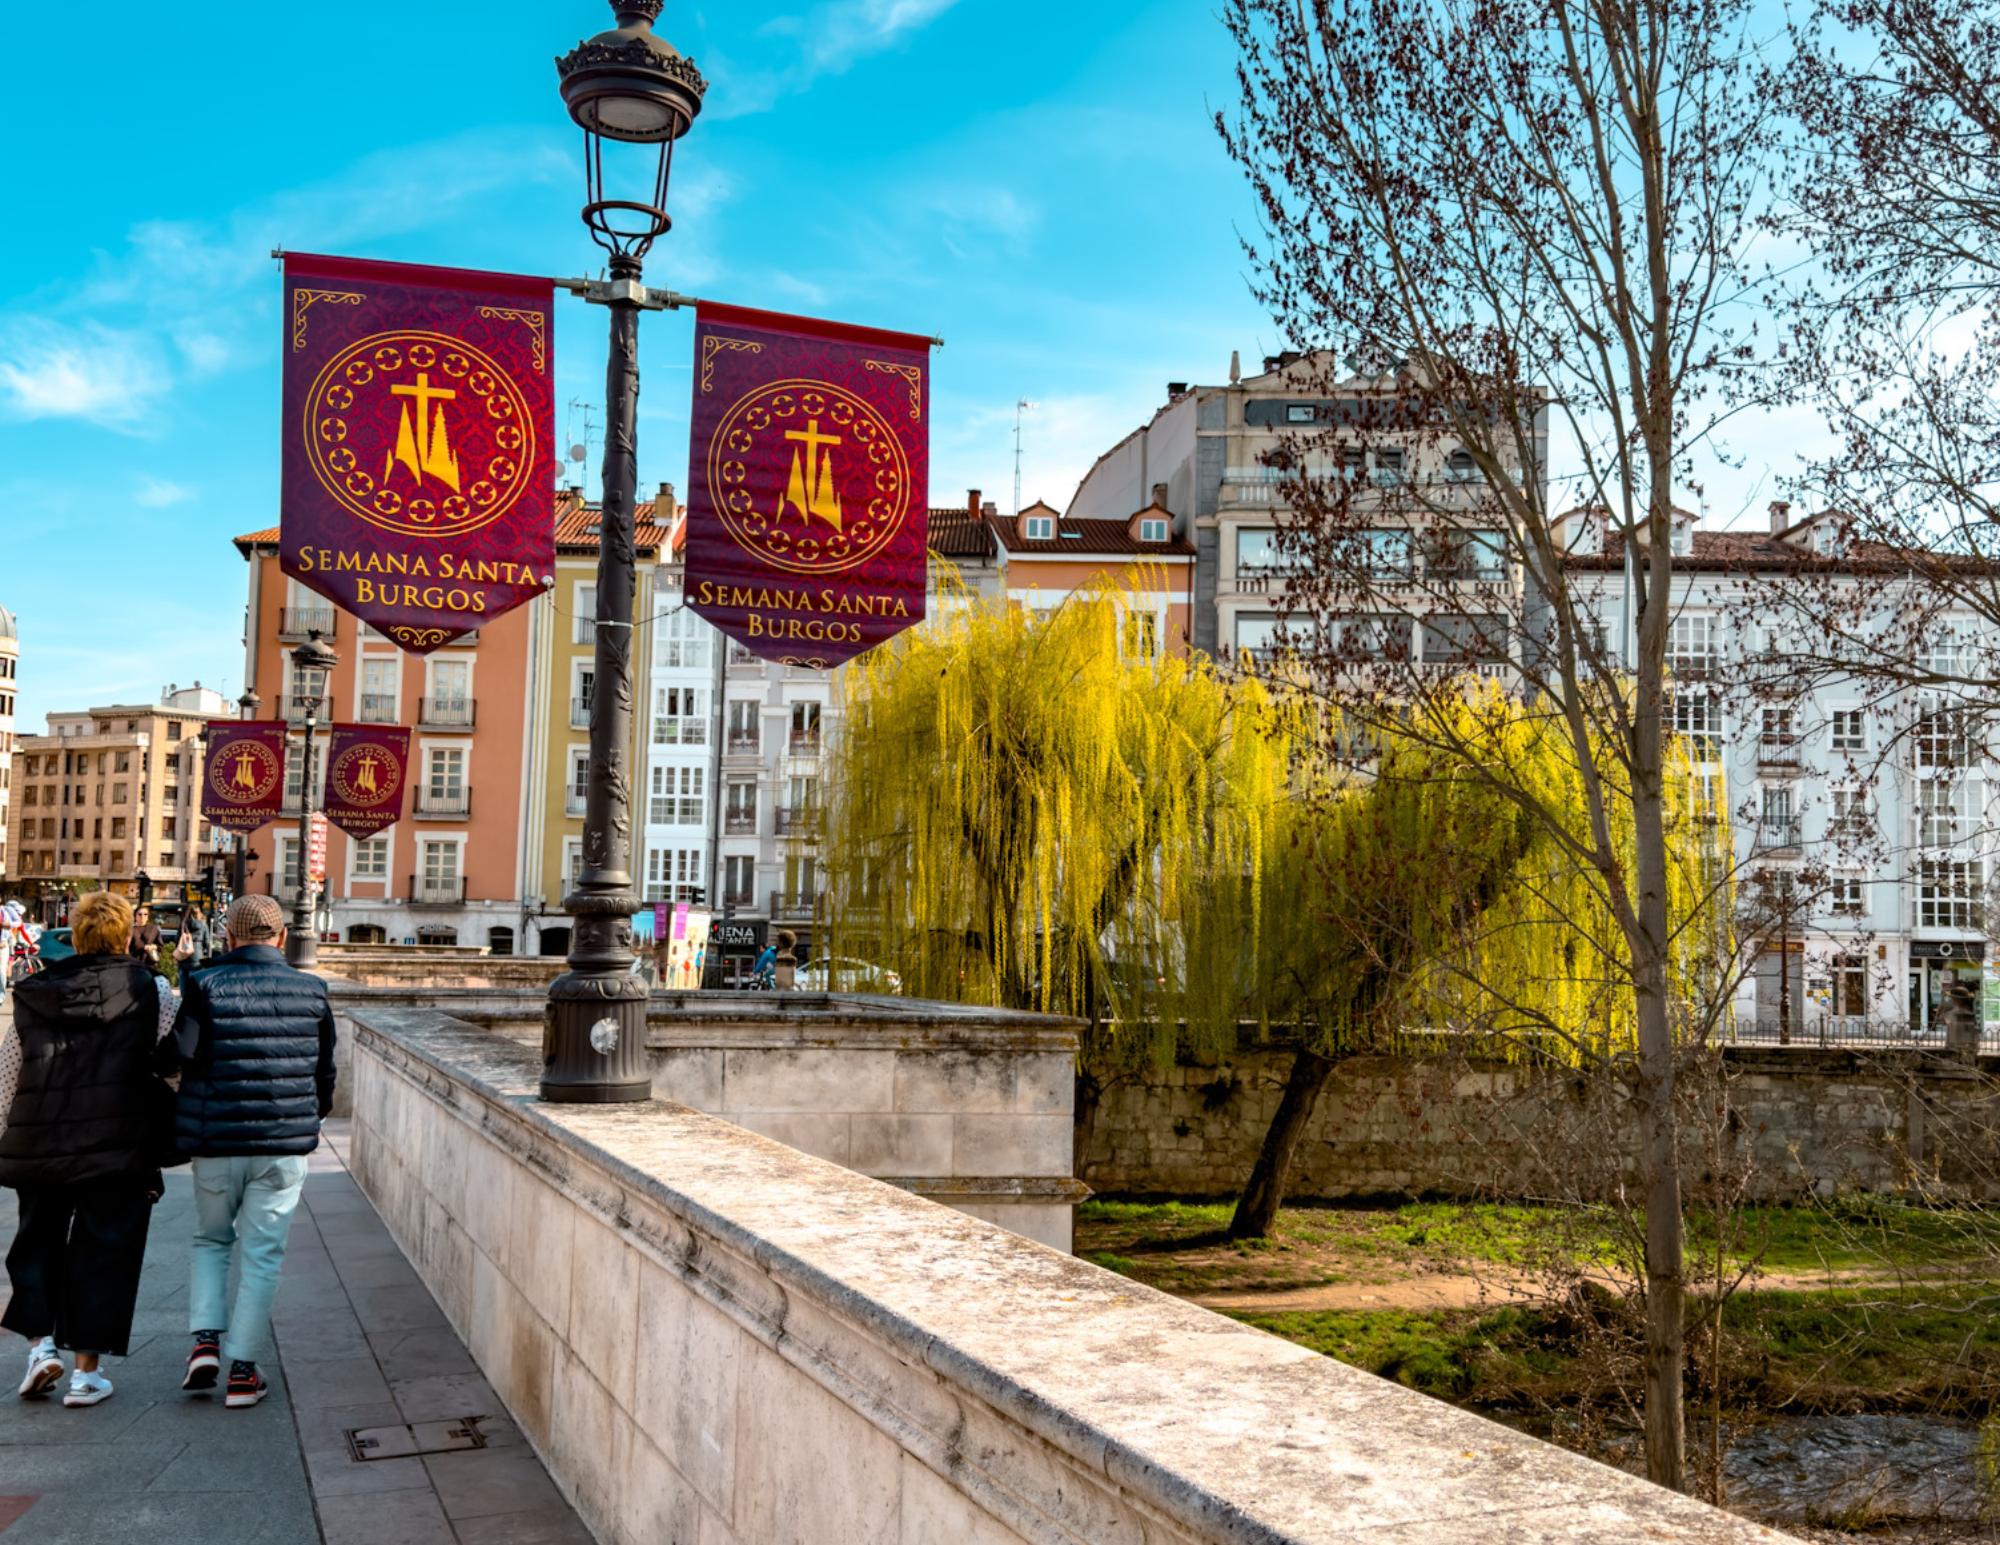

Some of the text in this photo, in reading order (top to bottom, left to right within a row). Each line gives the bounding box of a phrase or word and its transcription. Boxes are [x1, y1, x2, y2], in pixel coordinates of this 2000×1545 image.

[299, 546, 537, 586] SEMANA SANTA
[356, 578, 485, 612] BURGOS
[698, 581, 909, 618] SEMANA SANTA
[748, 613, 861, 642] BURGOS
[205, 807, 277, 817] SEMANA SANTA
[221, 816, 260, 825] BURGOS
[327, 809, 396, 820] SEMANA SANTA
[341, 818, 380, 829] BURGOS
